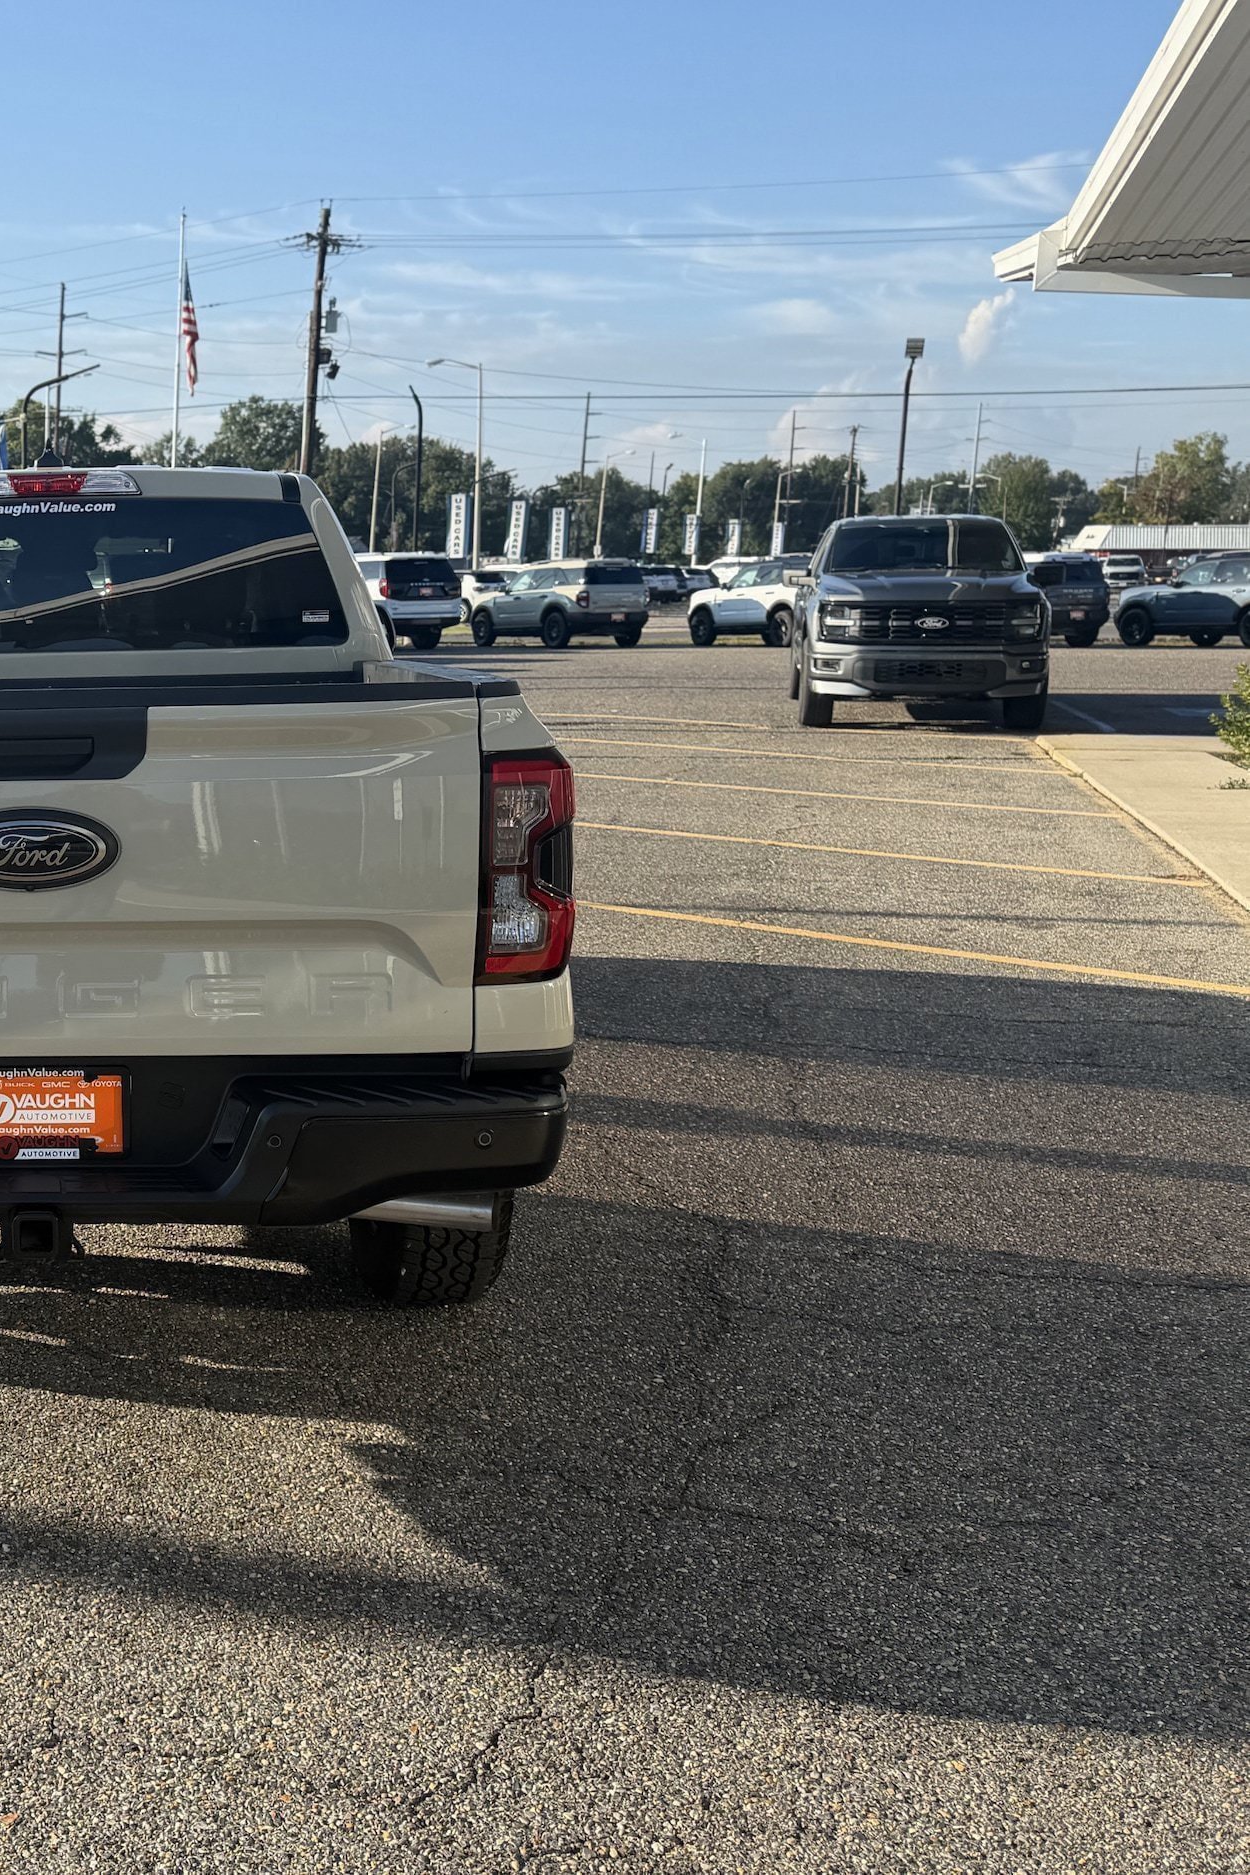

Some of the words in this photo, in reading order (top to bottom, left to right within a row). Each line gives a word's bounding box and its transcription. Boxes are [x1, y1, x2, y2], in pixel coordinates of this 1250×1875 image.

[454, 497, 462, 525] USED
[514, 504, 522, 529] USED
[453, 528, 461, 555] CARS
[91, 1080, 122, 1088] TOYOTA
[12, 1093, 95, 1108] VAUGHN
[18, 1112, 92, 1121] AUTOMOTIVE
[15, 1135, 80, 1147] VAUGHN
[21, 1150, 78, 1158] AUTOMOTIVE
